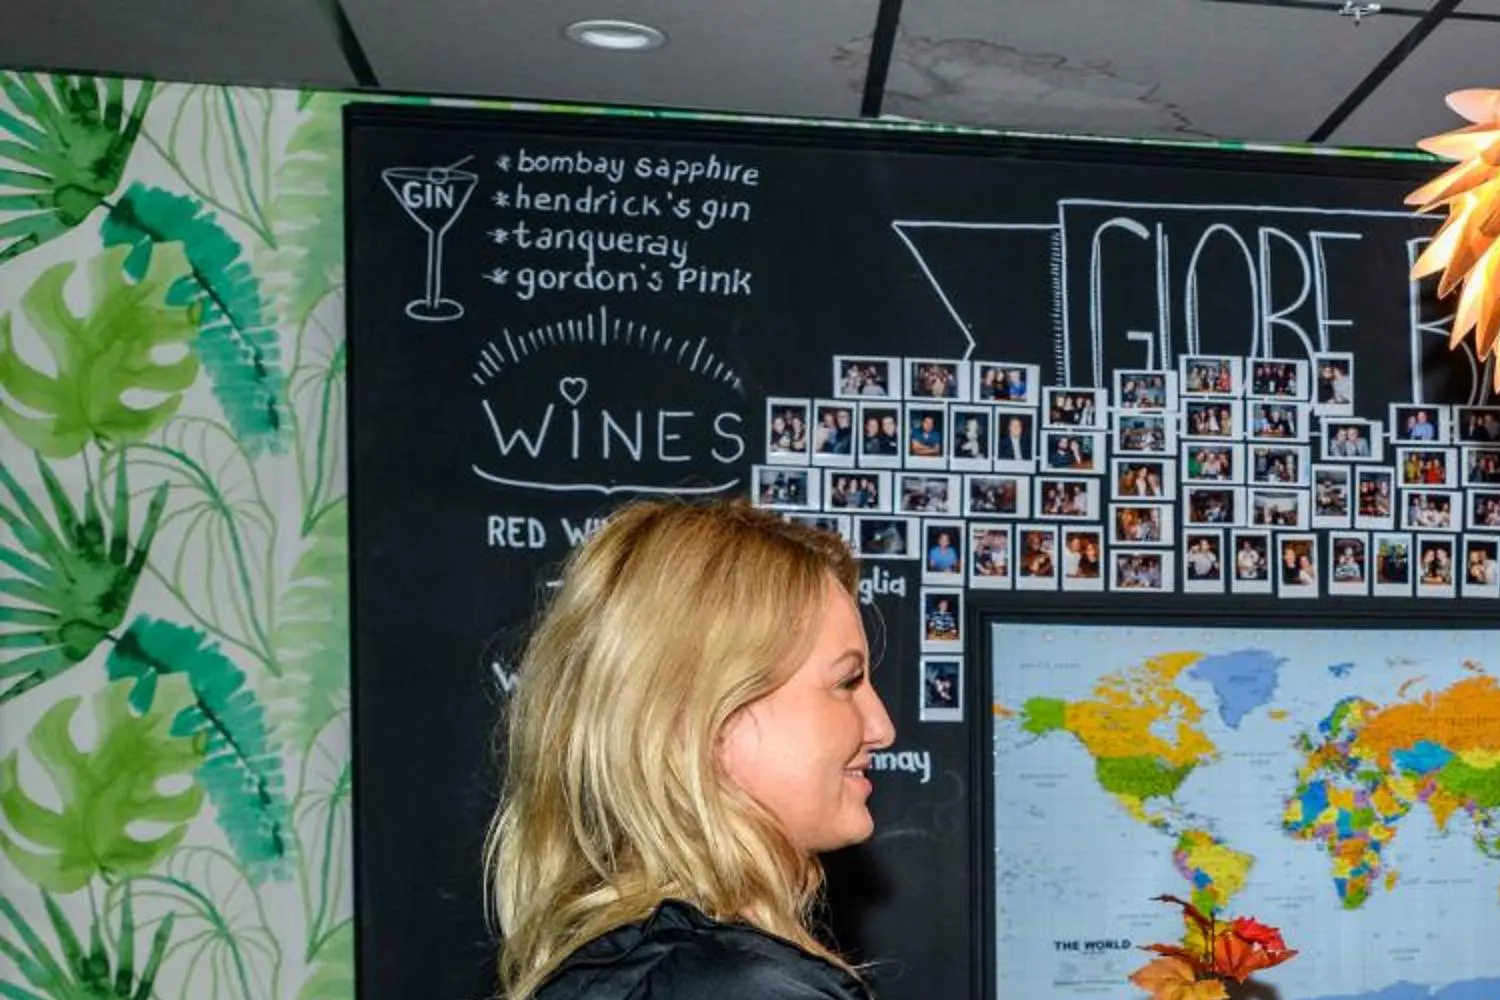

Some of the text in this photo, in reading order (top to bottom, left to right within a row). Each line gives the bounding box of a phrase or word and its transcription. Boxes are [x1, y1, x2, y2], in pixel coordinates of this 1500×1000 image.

[517, 148, 759, 186] bombay sapphire
[402, 181, 454, 208] GIN
[515, 182, 751, 230] hendrick's gin
[511, 220, 688, 269] tanqueray
[516, 262, 663, 300] gordon's
[487, 515, 547, 548] RED
[859, 565, 906, 605] glia
[1054, 938, 1132, 951] THE WORLD
